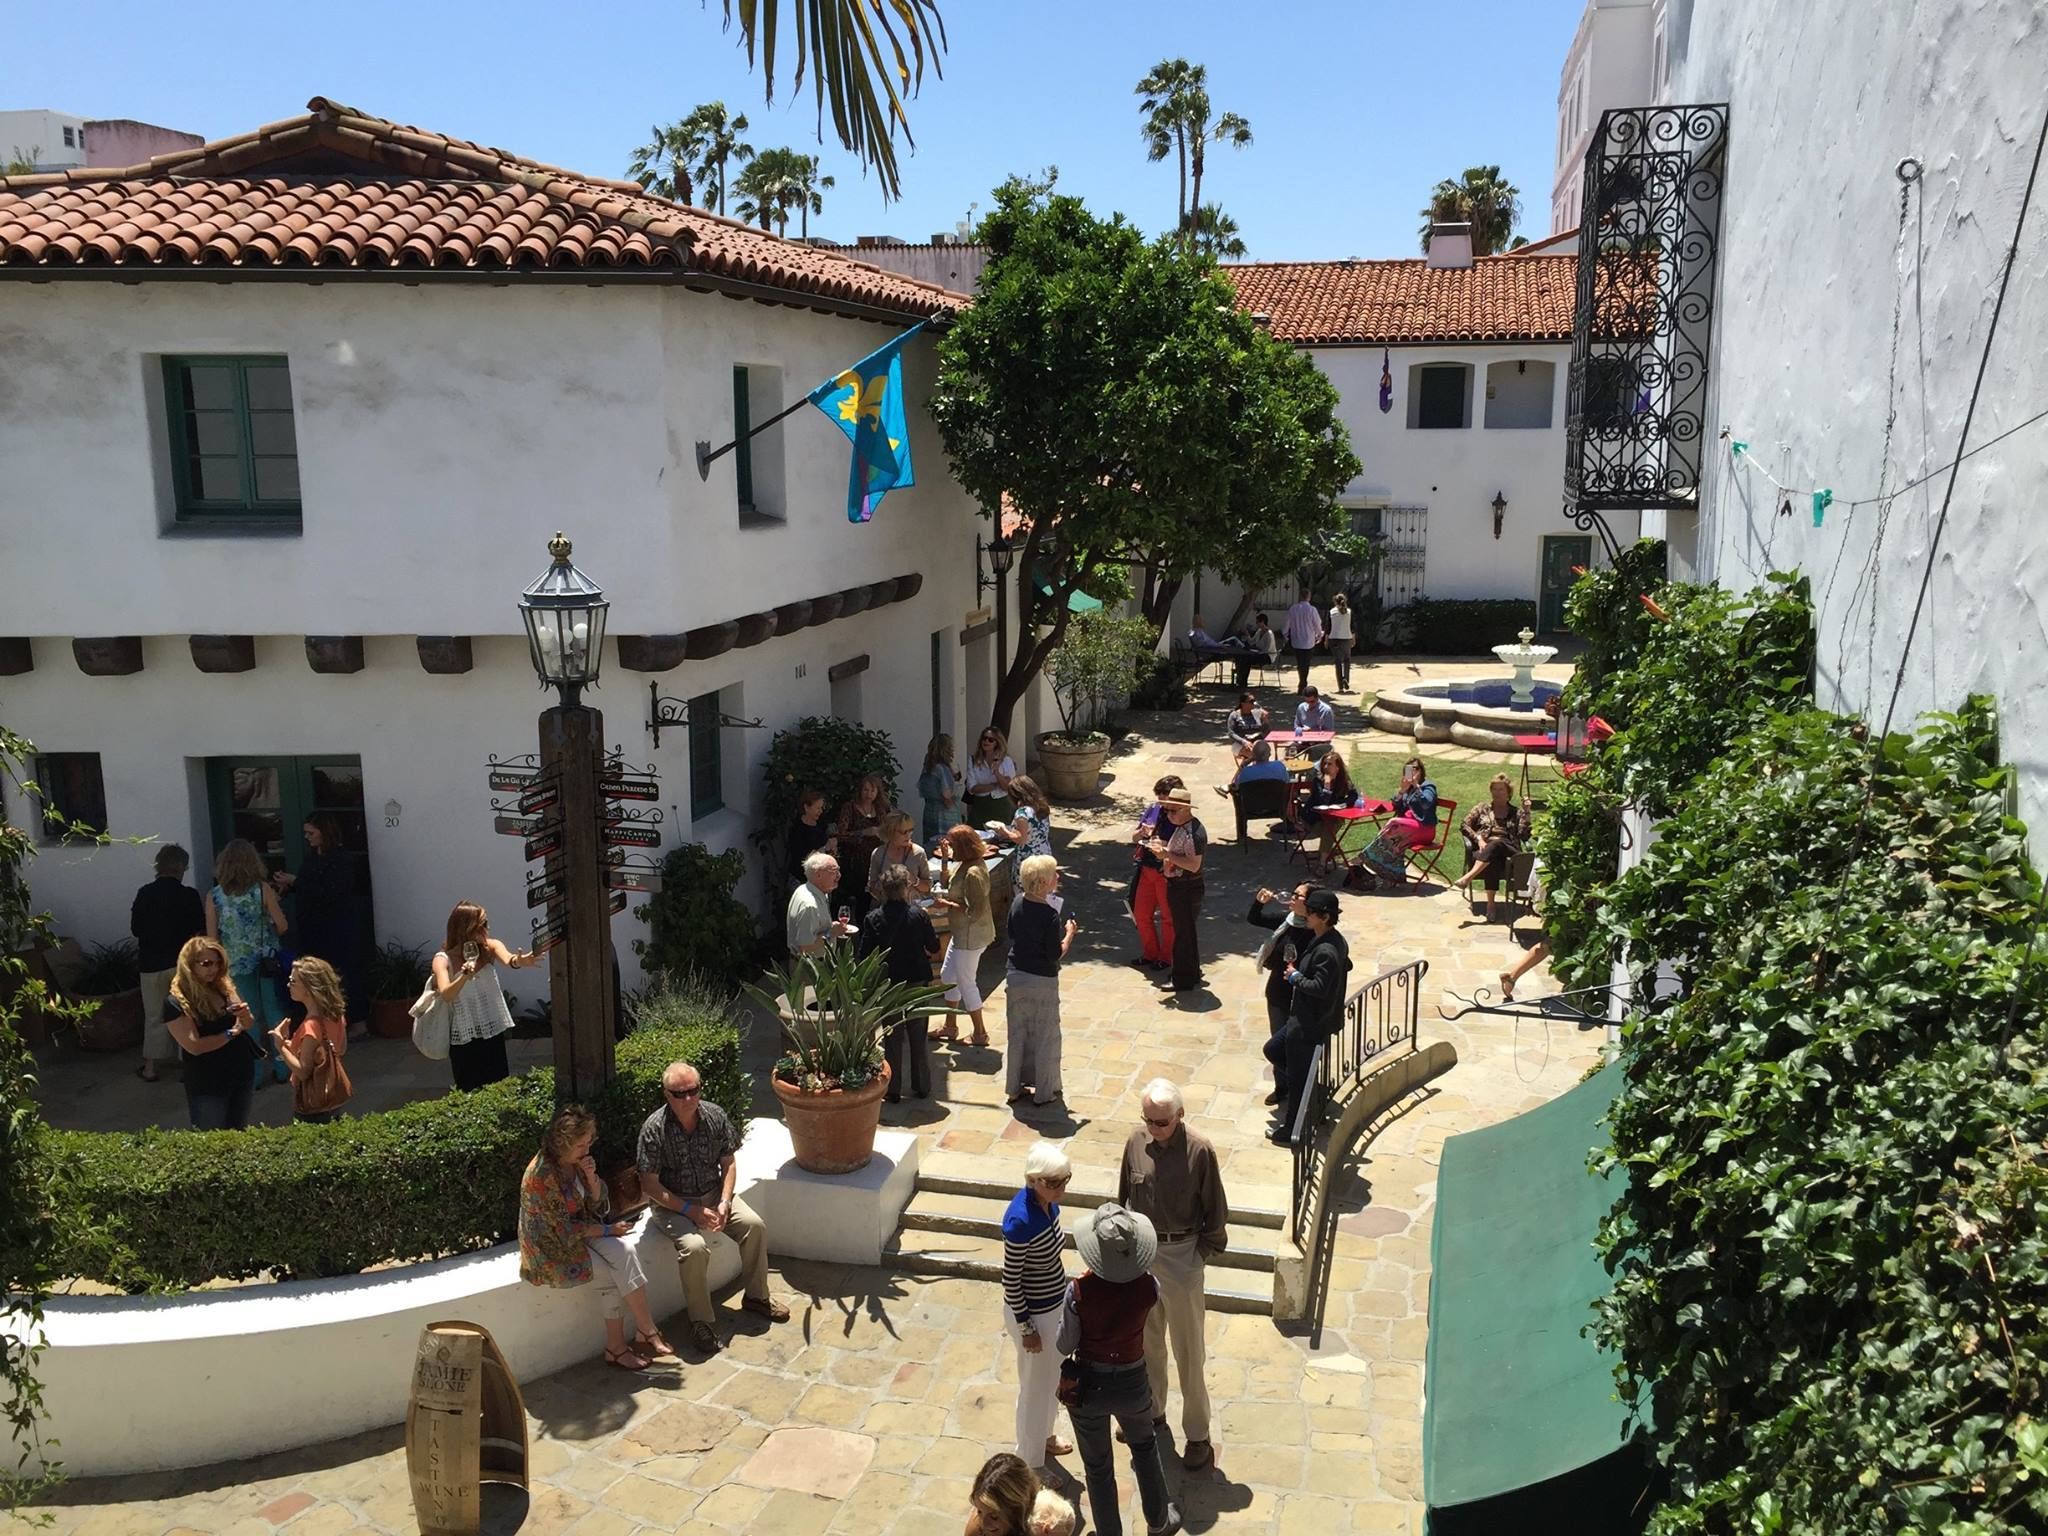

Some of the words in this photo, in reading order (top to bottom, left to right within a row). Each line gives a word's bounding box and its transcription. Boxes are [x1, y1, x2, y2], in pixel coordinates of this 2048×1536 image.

[384, 816, 400, 828] 20
[416, 1359, 472, 1382] JAMIE
[418, 1377, 466, 1393] SLONE
[416, 1481, 470, 1498] WINE
